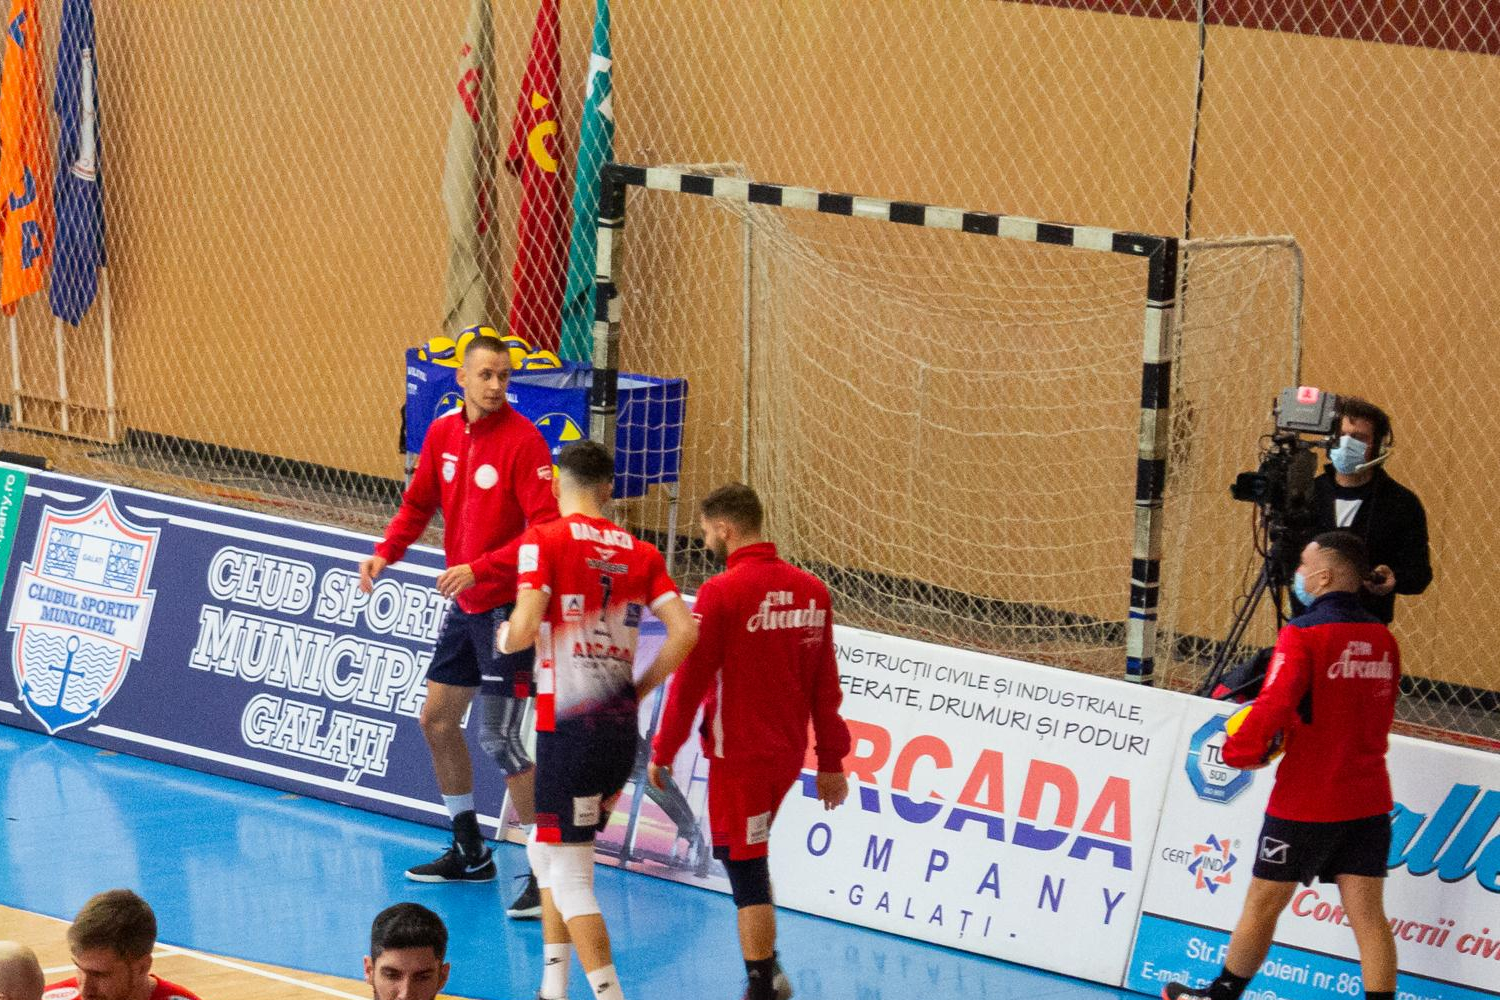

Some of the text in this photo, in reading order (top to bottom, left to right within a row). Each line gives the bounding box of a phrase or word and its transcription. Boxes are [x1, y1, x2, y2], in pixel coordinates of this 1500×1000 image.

[28, 583, 139, 621] CLUBUL SPORTIV
[40, 606, 117, 636] MUNICIPAL
[208, 546, 455, 644] CLUB SPORT
[189, 604, 466, 728] MUNICIPA
[935, 666, 990, 690] CIVILE
[1016, 682, 1144, 725] INDUSTRIALE,
[241, 693, 397, 785] GALAȚI
[929, 694, 1032, 731] DRUMURI
[1063, 722, 1150, 756] PODURI
[1162, 847, 1192, 865] CERT
